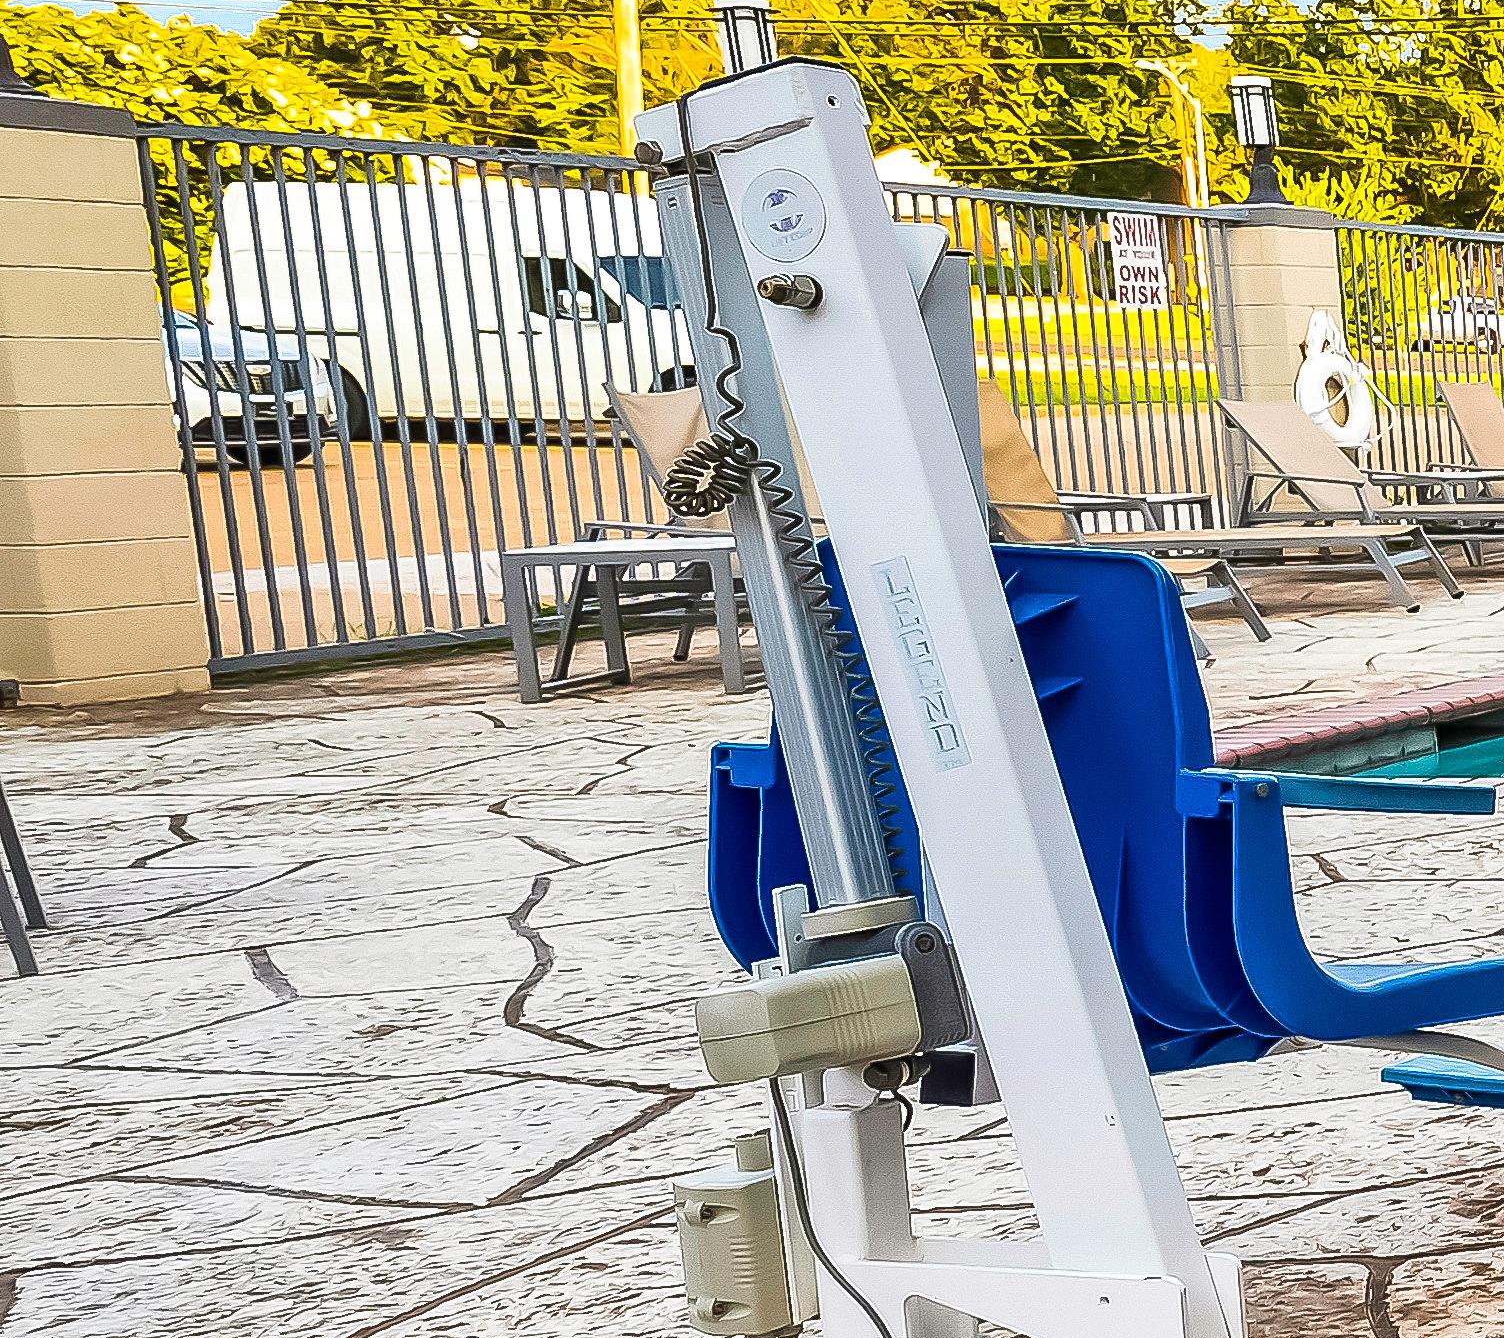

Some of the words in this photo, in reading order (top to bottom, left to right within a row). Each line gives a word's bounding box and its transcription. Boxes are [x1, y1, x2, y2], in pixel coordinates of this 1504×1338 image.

[1113, 215, 1157, 247] SWIM
[1120, 265, 1160, 283] OWN
[1119, 285, 1162, 305] RISK
